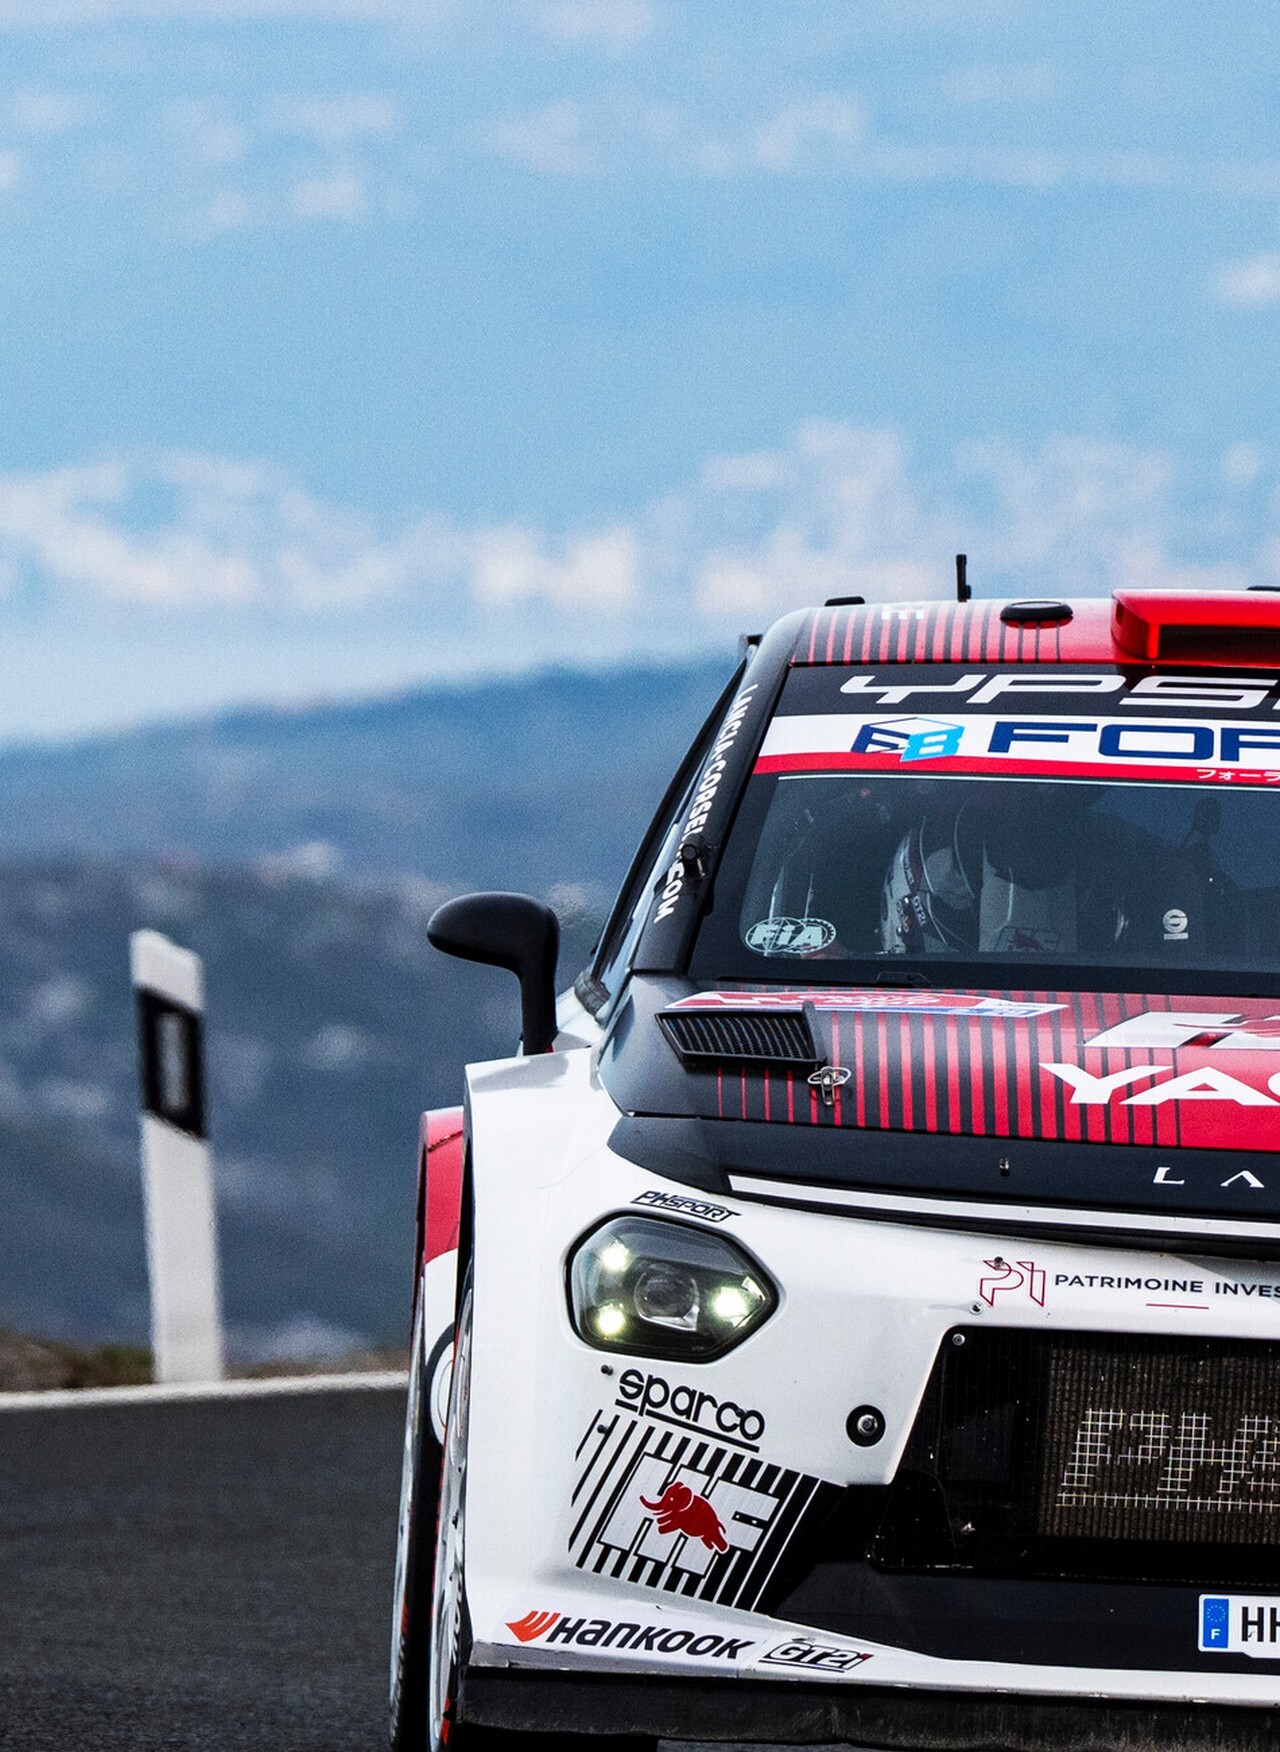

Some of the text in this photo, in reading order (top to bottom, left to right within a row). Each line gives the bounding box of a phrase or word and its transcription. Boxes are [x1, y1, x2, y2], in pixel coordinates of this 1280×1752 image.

[1055, 1274, 1203, 1293] PATRIMOINE
[618, 1369, 766, 1442] sparco
[1210, 1629, 1221, 1640] F
